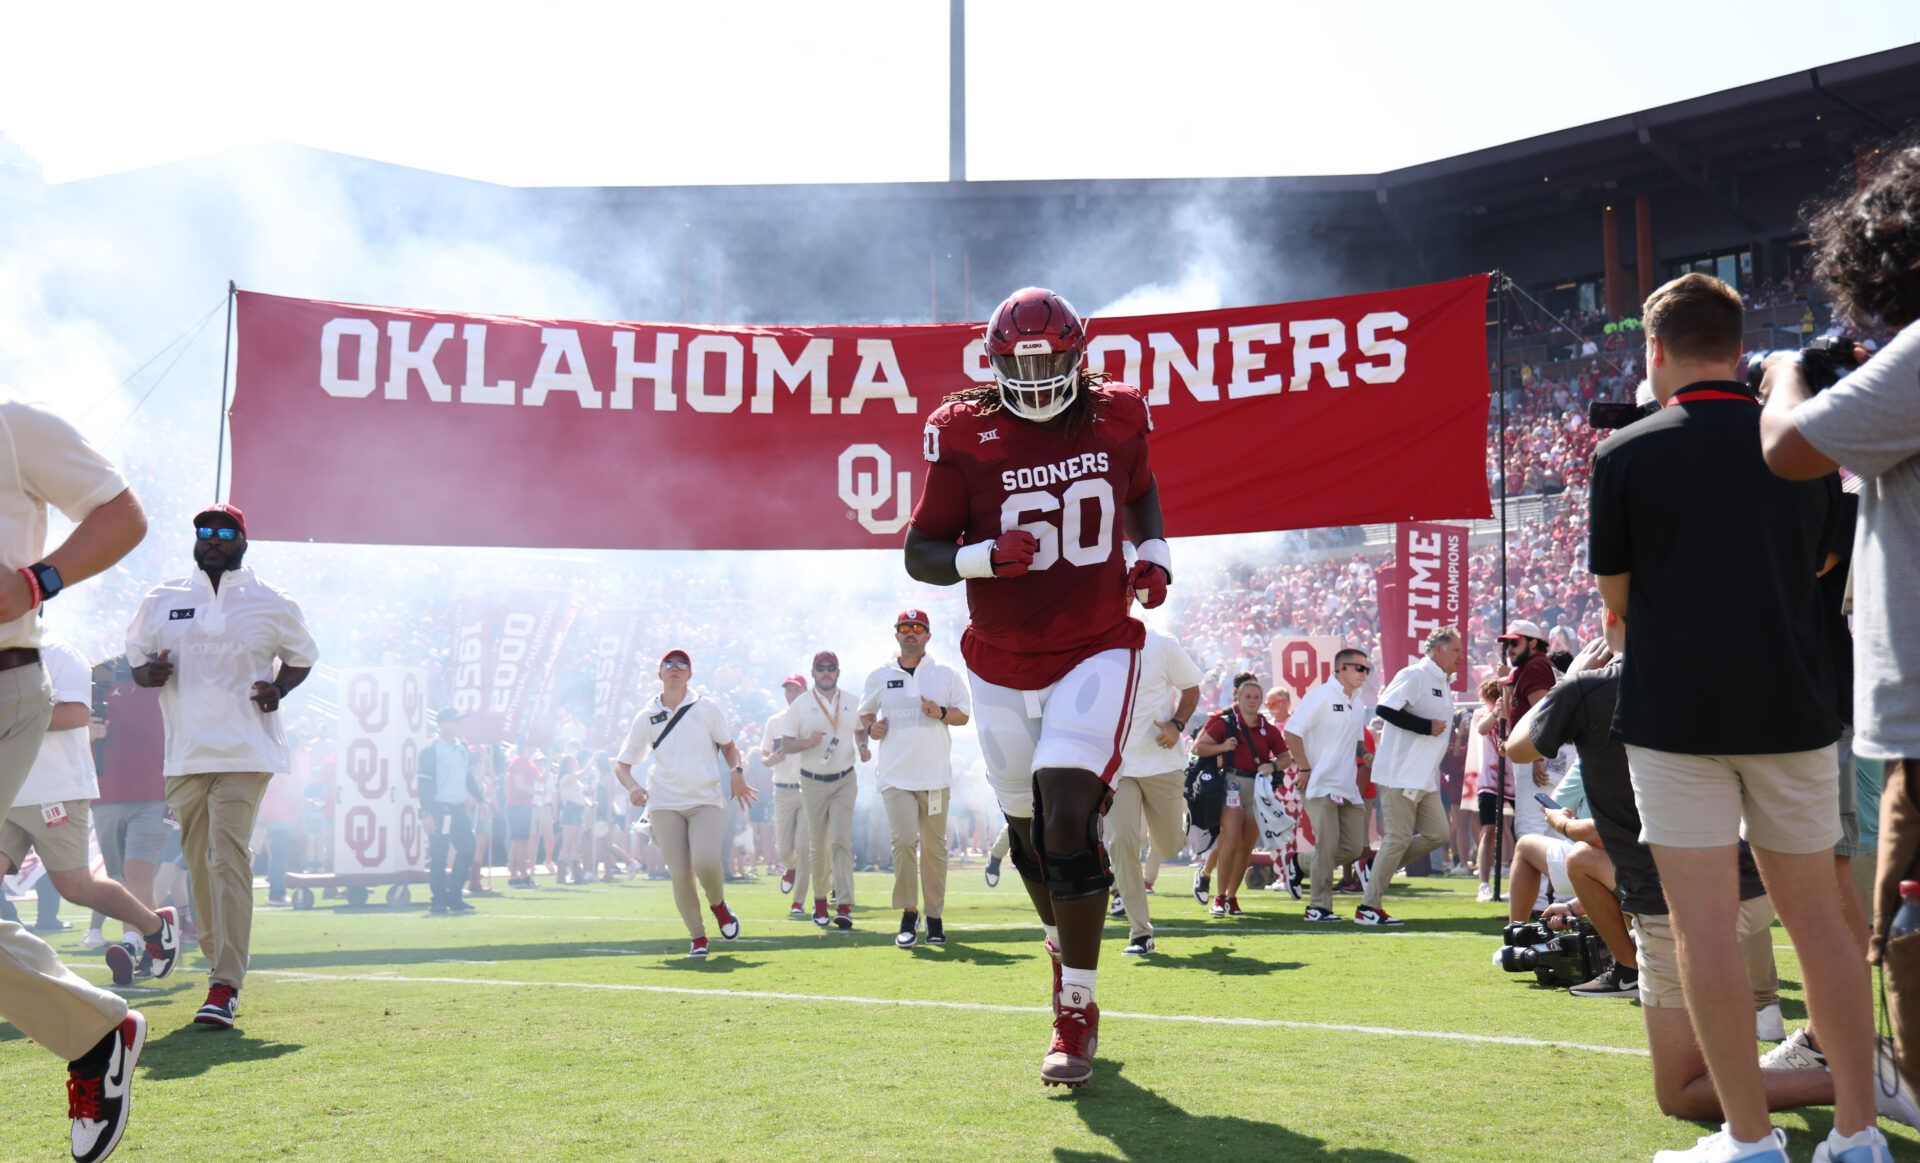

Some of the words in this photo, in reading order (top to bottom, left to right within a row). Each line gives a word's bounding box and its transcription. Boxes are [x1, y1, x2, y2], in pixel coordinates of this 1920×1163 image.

[320, 317, 918, 415] OKLAHOMA
[963, 310, 1409, 406] ONERS
[838, 443, 912, 534] OU
[1002, 452, 1109, 491] SOONERS
[1000, 477, 1116, 571] 60
[1407, 530, 1441, 665] -TIME
[1447, 534, 1460, 612] CHAMPIONS
[348, 673, 390, 733] OU
[403, 673, 423, 733] OU
[453, 621, 483, 715] 1956
[491, 612, 536, 714] 2000
[346, 738, 389, 799] OU
[344, 806, 387, 868] OU
[400, 805, 421, 866] OU
